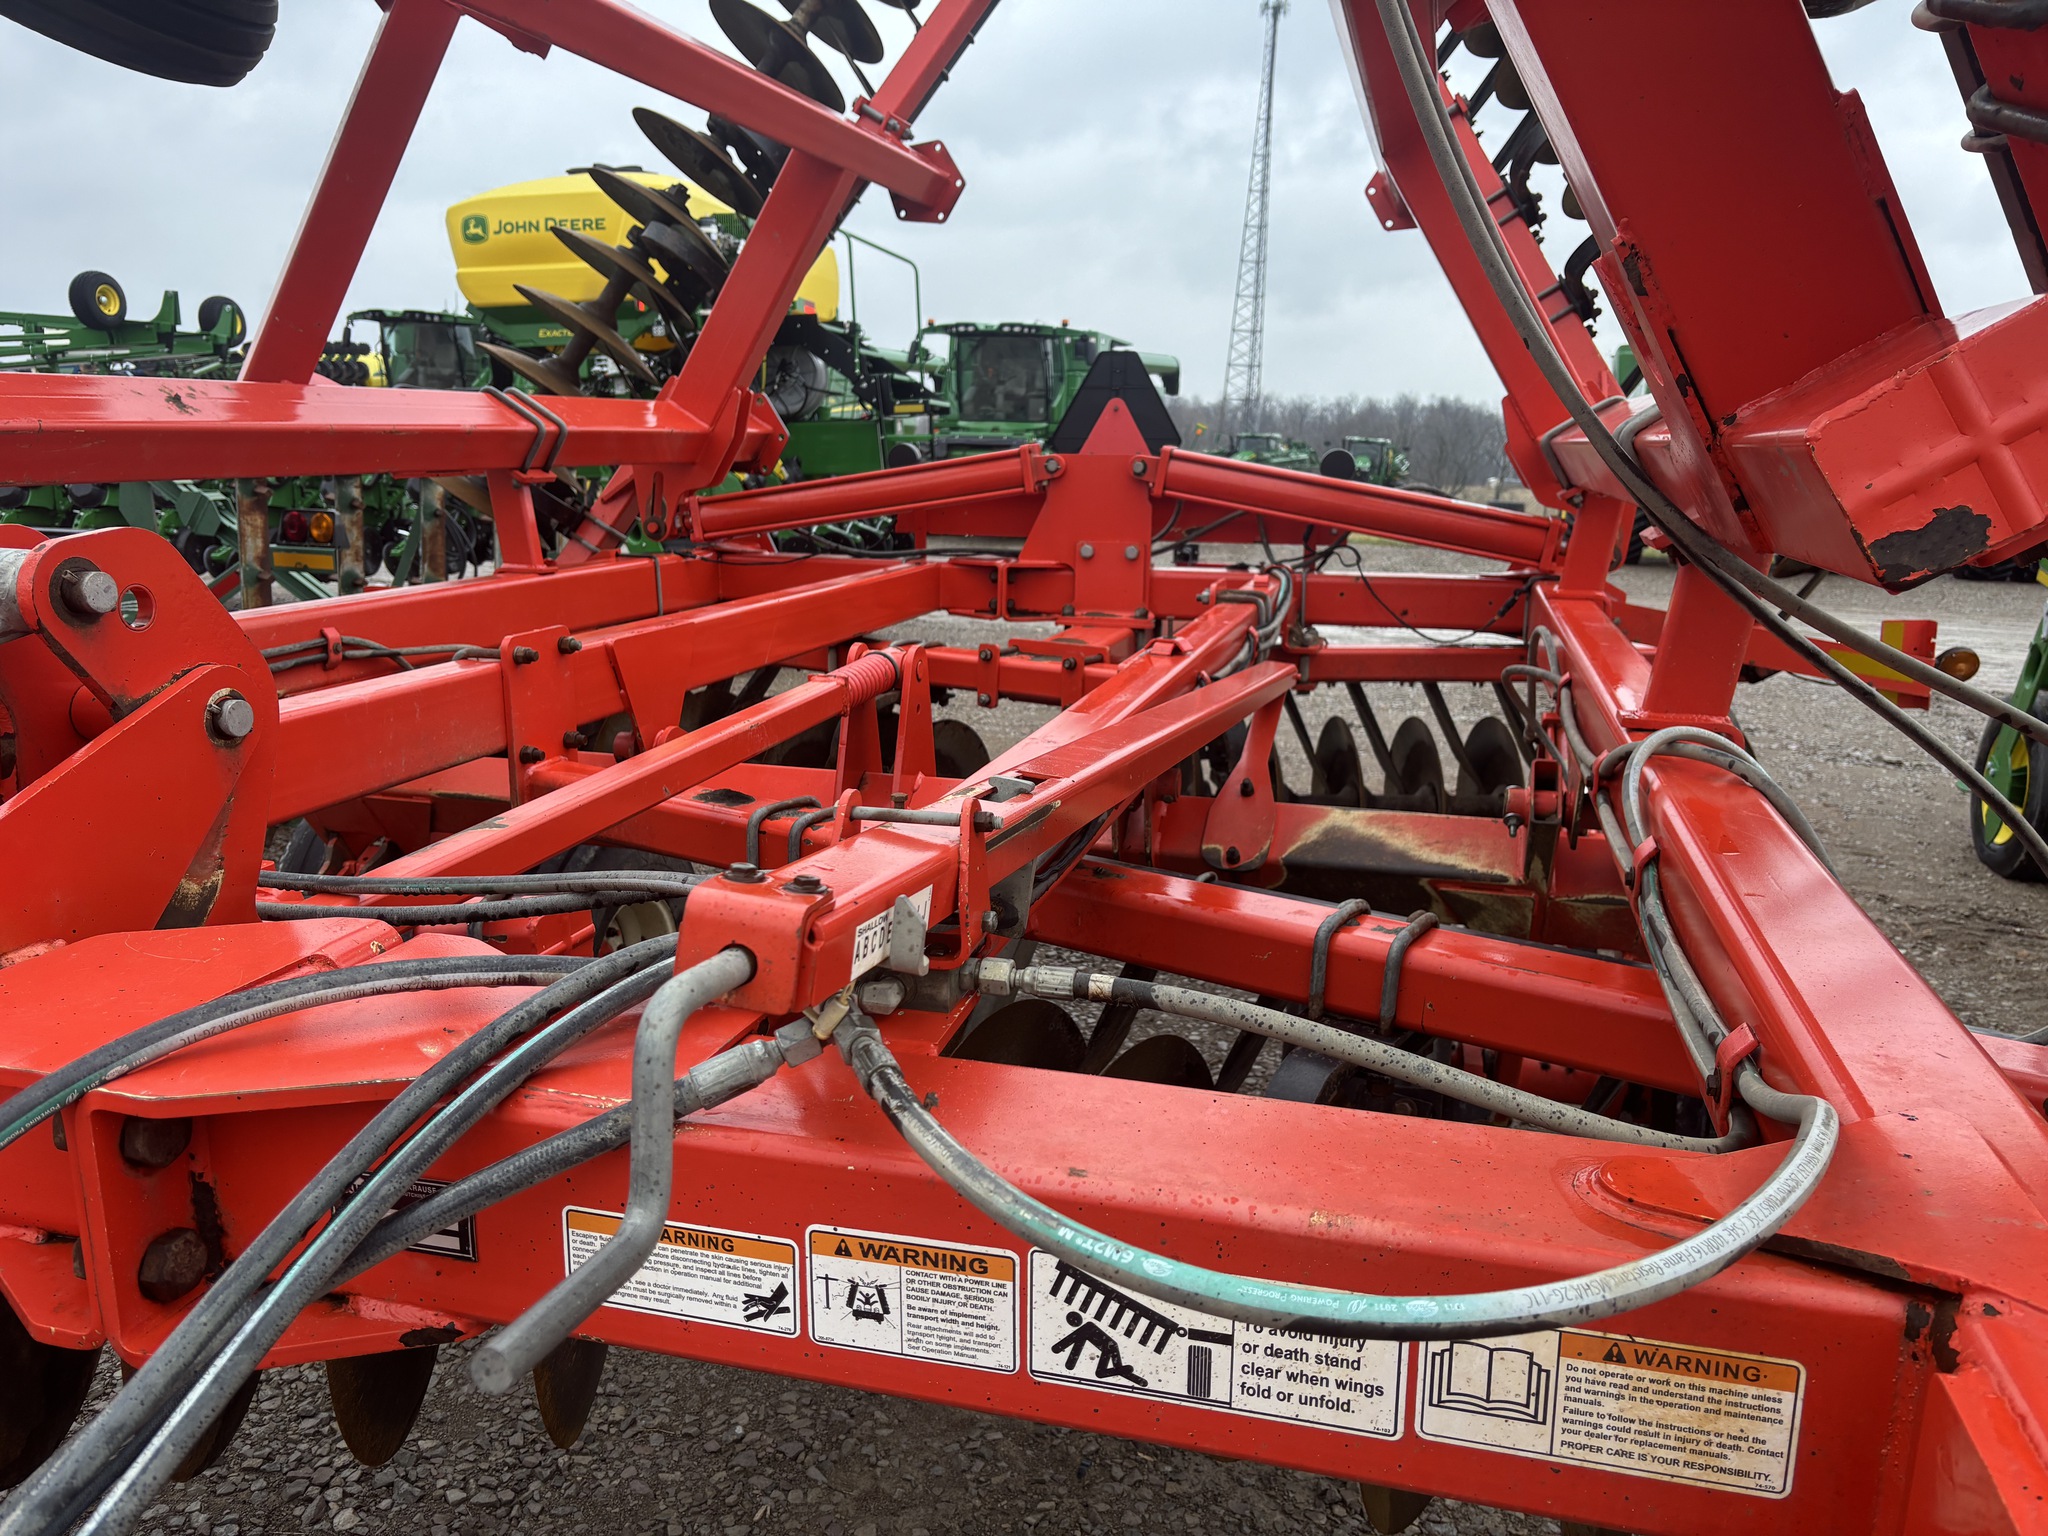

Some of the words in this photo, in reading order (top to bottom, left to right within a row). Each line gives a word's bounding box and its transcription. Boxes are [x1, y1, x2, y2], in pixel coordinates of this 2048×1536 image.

[493, 219, 539, 235] JOHN
[545, 218, 605, 231] DEERE
[858, 912, 889, 937] SHALLOW
[250, 1001, 296, 1020] Resistant
[217, 1015, 249, 1031] MSHA
[660, 1228, 735, 1252] ARNING
[1723, 1223, 1745, 1241] SAE
[572, 1230, 598, 1241] Escaping
[671, 1248, 698, 1257] penetrate
[725, 1256, 748, 1266] causing
[750, 1261, 772, 1269] serious
[1691, 1233, 1727, 1259] 100R16
[671, 1255, 711, 1267] disconnecting
[713, 1262, 740, 1271] hydraulic
[741, 1265, 758, 1274] lines,
[759, 1269, 780, 1279] tighten
[858, 1242, 989, 1275] WARNING
[1663, 1246, 1696, 1269] Flame
[670, 1270, 698, 1280] operation
[700, 1274, 722, 1282] manual
[733, 1280, 762, 1289] additional
[696, 1266, 717, 1275] inspect
[743, 1274, 762, 1282] before
[905, 1270, 938, 1279] CONTACT
[964, 1278, 990, 1287] POWER
[1610, 1261, 1665, 1286] Resistant
[653, 1282, 671, 1290] doctor
[712, 1292, 724, 1300] Any
[906, 1286, 929, 1294] CAUSE
[964, 1294, 994, 1304] SERIOUS
[918, 1280, 941, 1289] OTHER
[942, 1283, 992, 1295] OBSTRUCTION
[993, 1290, 1008, 1298] CAN
[1573, 1276, 1609, 1299] MSHA
[657, 1290, 688, 1302] surgically
[687, 1296, 713, 1305] removed
[714, 1299, 731, 1308] within
[906, 1294, 930, 1303] BODILY
[933, 1298, 956, 1306] INJURY
[970, 1303, 994, 1312] DEATH.
[1291, 1294, 1339, 1308] POWERING
[1375, 1303, 1398, 1311] 2011
[907, 1312, 939, 1323] transport
[940, 1316, 959, 1325] width
[949, 1311, 986, 1321] implement
[907, 1330, 935, 1339] transport
[973, 1339, 1001, 1349] transport
[924, 1324, 961, 1335] attachments
[922, 1346, 952, 1356] Operation
[1242, 1342, 1259, 1354] or
[1264, 1343, 1309, 1362] death
[1314, 1352, 1361, 1370] stand
[1634, 1348, 1761, 1382] WARNING
[1241, 1362, 1281, 1379] clear
[1286, 1370, 1329, 1387] when
[1334, 1378, 1384, 1398] wings
[1566, 1364, 1579, 1372] Do
[1581, 1367, 1596, 1375] not
[1599, 1370, 1634, 1381] operate
[1649, 1377, 1671, 1387] work
[1688, 1383, 1706, 1392] this
[1709, 1387, 1749, 1398] machine
[1751, 1394, 1783, 1404] unless
[1240, 1382, 1271, 1399] fold
[1276, 1390, 1294, 1403] or
[1298, 1394, 1355, 1413] unfold.
[1564, 1395, 1605, 1407] manuals.
[1565, 1375, 1582, 1385] you
[1585, 1377, 1607, 1387] have
[1609, 1381, 1629, 1390] read
[1632, 1385, 1649, 1394] and
[1651, 1387, 1705, 1403] understand
[1707, 1395, 1722, 1405] the
[1725, 1399, 1781, 1415] instructions
[1584, 1387, 1626, 1401] warnings
[1628, 1394, 1637, 1402] in
[1640, 1395, 1654, 1405] the
[1656, 1400, 1701, 1413] operation
[1703, 1406, 1722, 1416] and
[1724, 1410, 1784, 1425] maintenance
[1563, 1406, 1594, 1417] Failure
[1608, 1413, 1636, 1424] follow
[1638, 1418, 1653, 1427] the
[1655, 1420, 1711, 1437] instructions
[1714, 1430, 1724, 1438] or
[1727, 1432, 1749, 1442] heed
[1752, 1437, 1766, 1445] the
[1561, 1427, 1582, 1437] your
[1584, 1430, 1613, 1441] dealer
[1615, 1434, 1628, 1443] for
[1630, 1437, 1687, 1454] replacement
[1689, 1448, 1731, 1460] manuals.
[1562, 1418, 1603, 1430] warnings
[1606, 1424, 1631, 1434] could
[1634, 1428, 1661, 1439] result
[1663, 1432, 1671, 1441] in
[1674, 1436, 1701, 1447] injury
[1703, 1439, 1714, 1447] or
[1716, 1442, 1744, 1453] death.
[1747, 1446, 1784, 1458] Contact
[1560, 1440, 1604, 1454] PROPER
[1606, 1446, 1635, 1459] CARE
[1638, 1453, 1648, 1462] IS
[1650, 1454, 1680, 1467] YOUR
[1683, 1462, 1772, 1482] RESPONSIBILITY.
